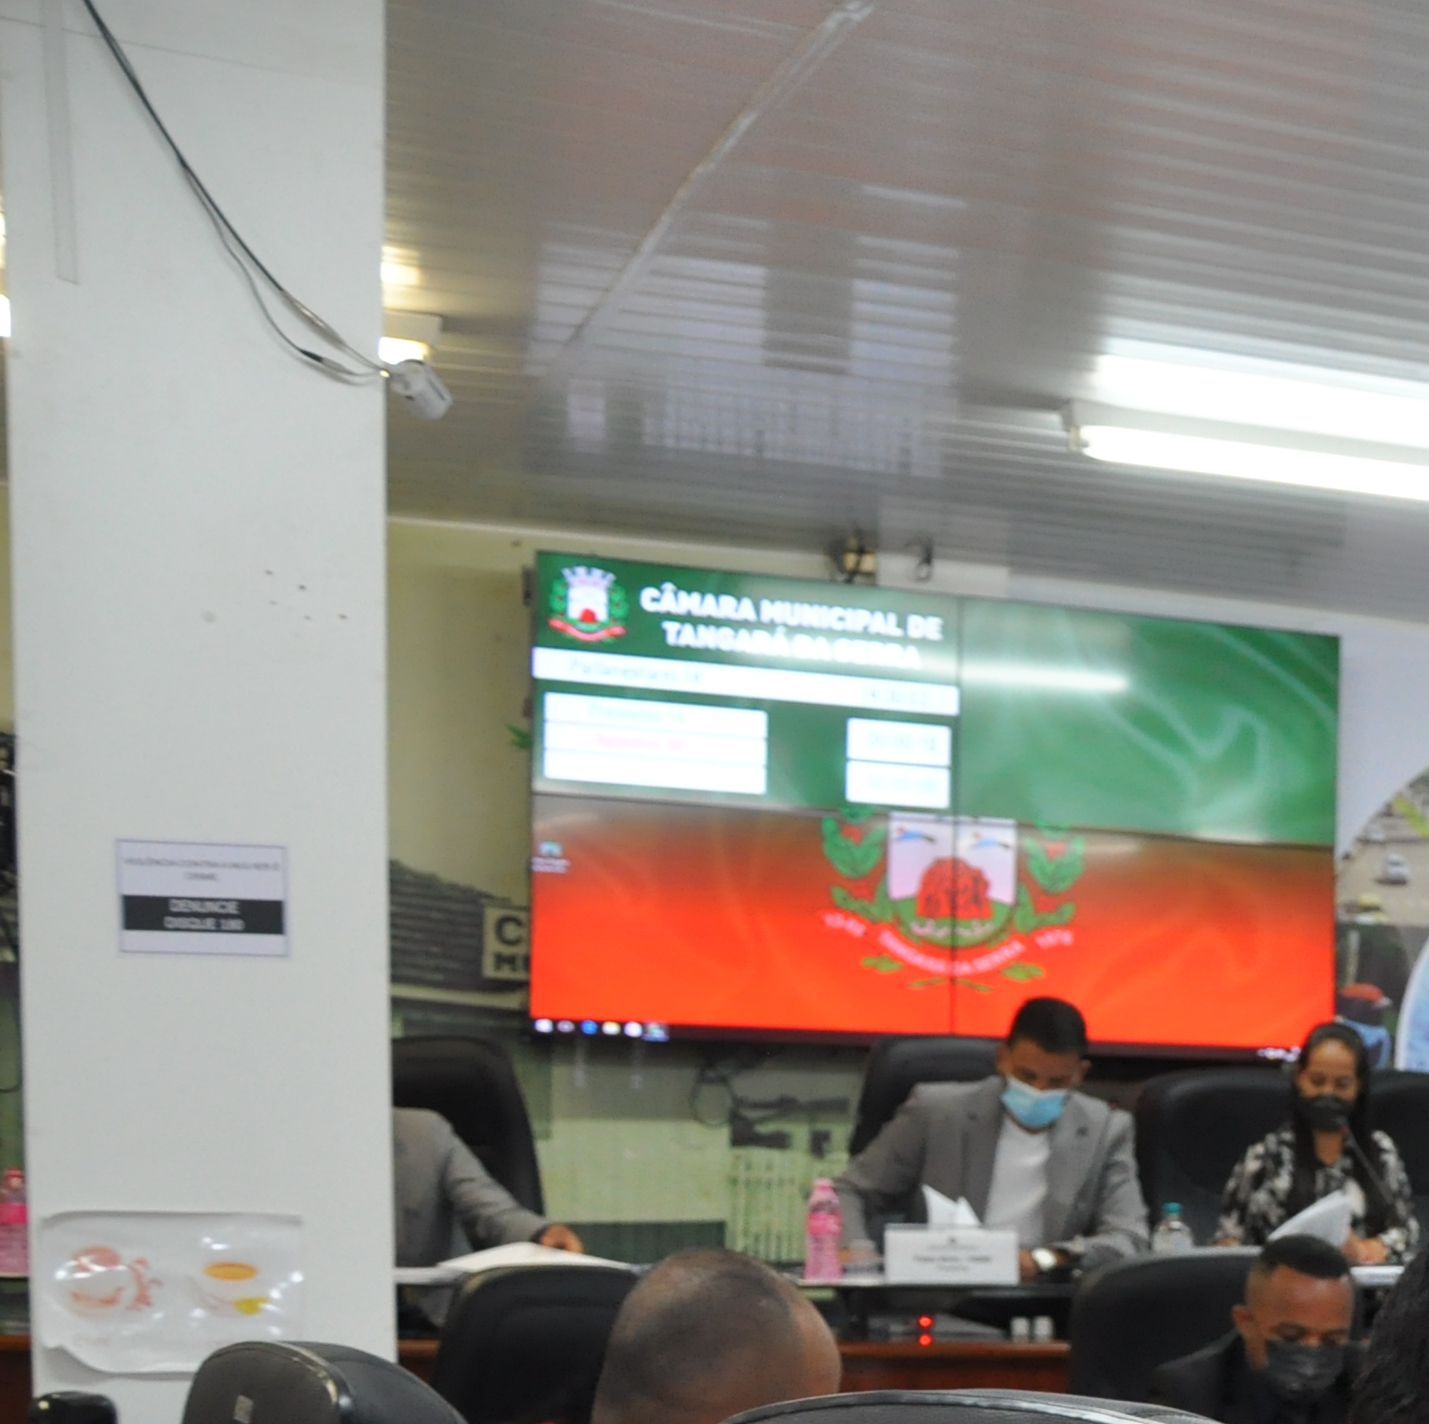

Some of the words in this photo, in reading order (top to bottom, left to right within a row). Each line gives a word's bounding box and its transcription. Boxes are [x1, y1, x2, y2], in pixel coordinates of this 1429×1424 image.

[639, 582, 758, 622] CÂMARA
[759, 598, 904, 637] MUNICIPAL
[906, 614, 943, 641] DE
